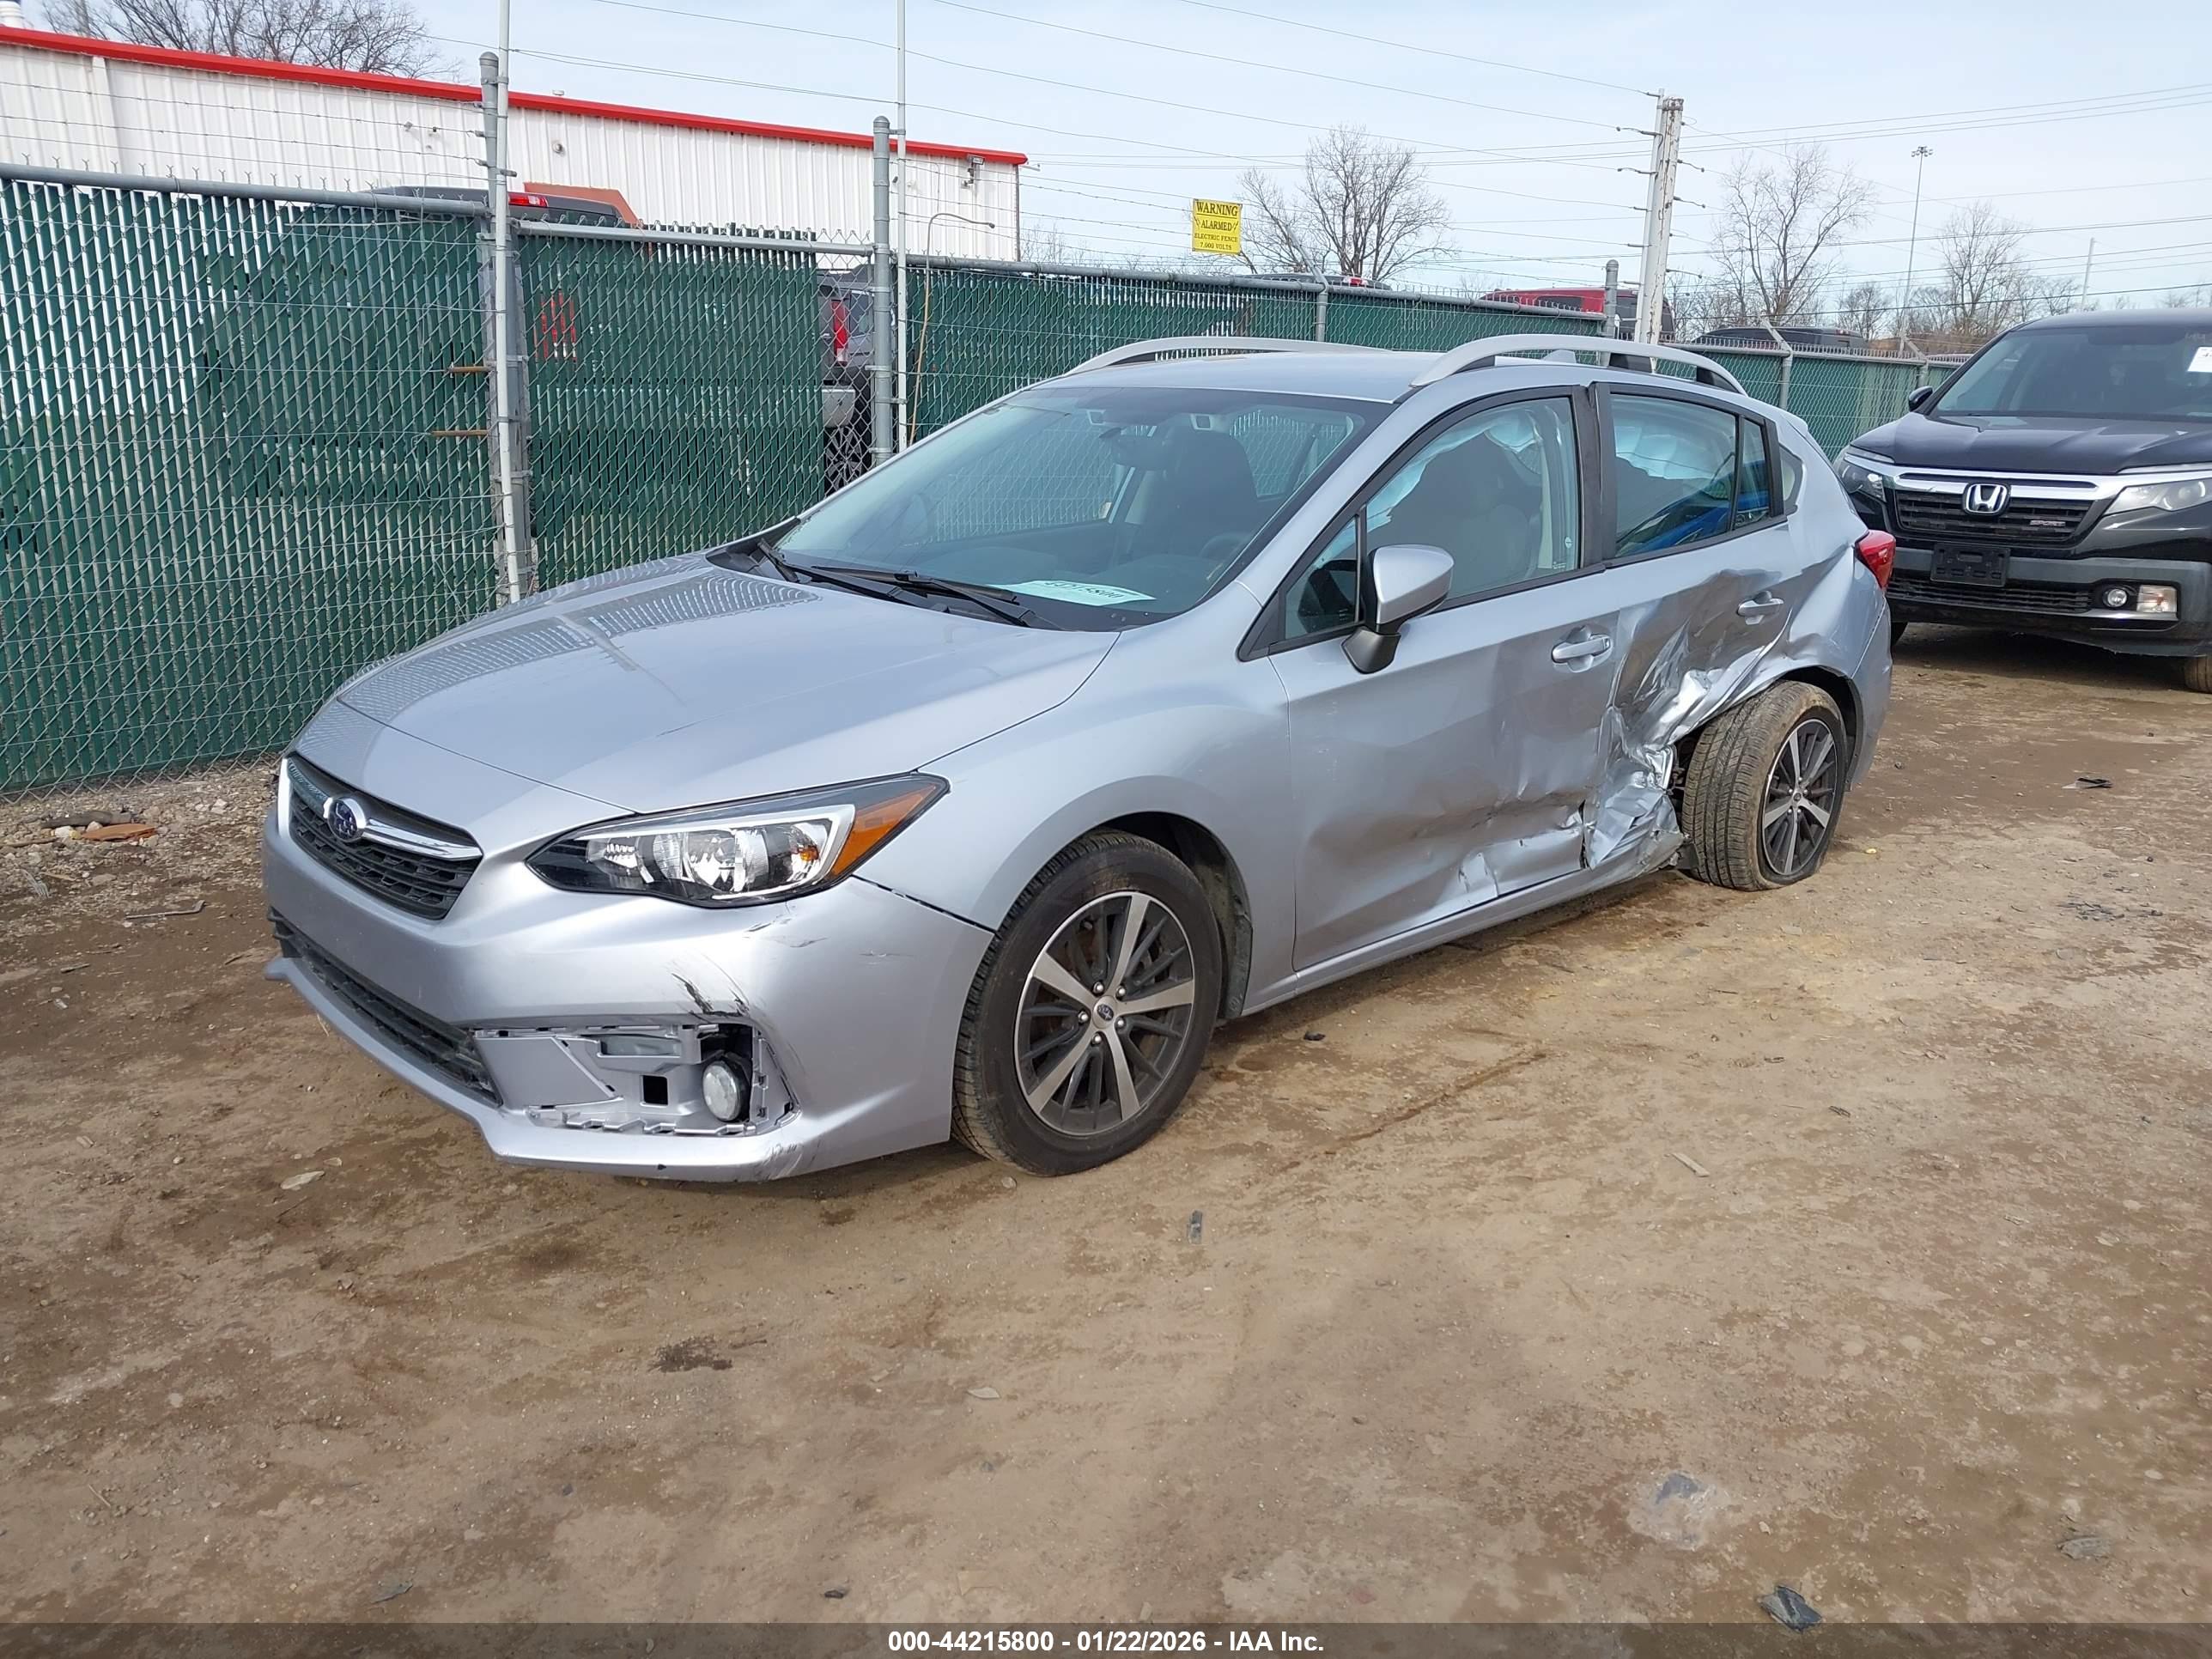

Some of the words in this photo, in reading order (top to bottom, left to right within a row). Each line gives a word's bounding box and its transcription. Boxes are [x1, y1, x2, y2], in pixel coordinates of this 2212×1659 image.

[1196, 202, 1238, 216] WARNING
[1200, 219, 1232, 231] ALARMED
[1194, 233, 1219, 241] ELECTRIC
